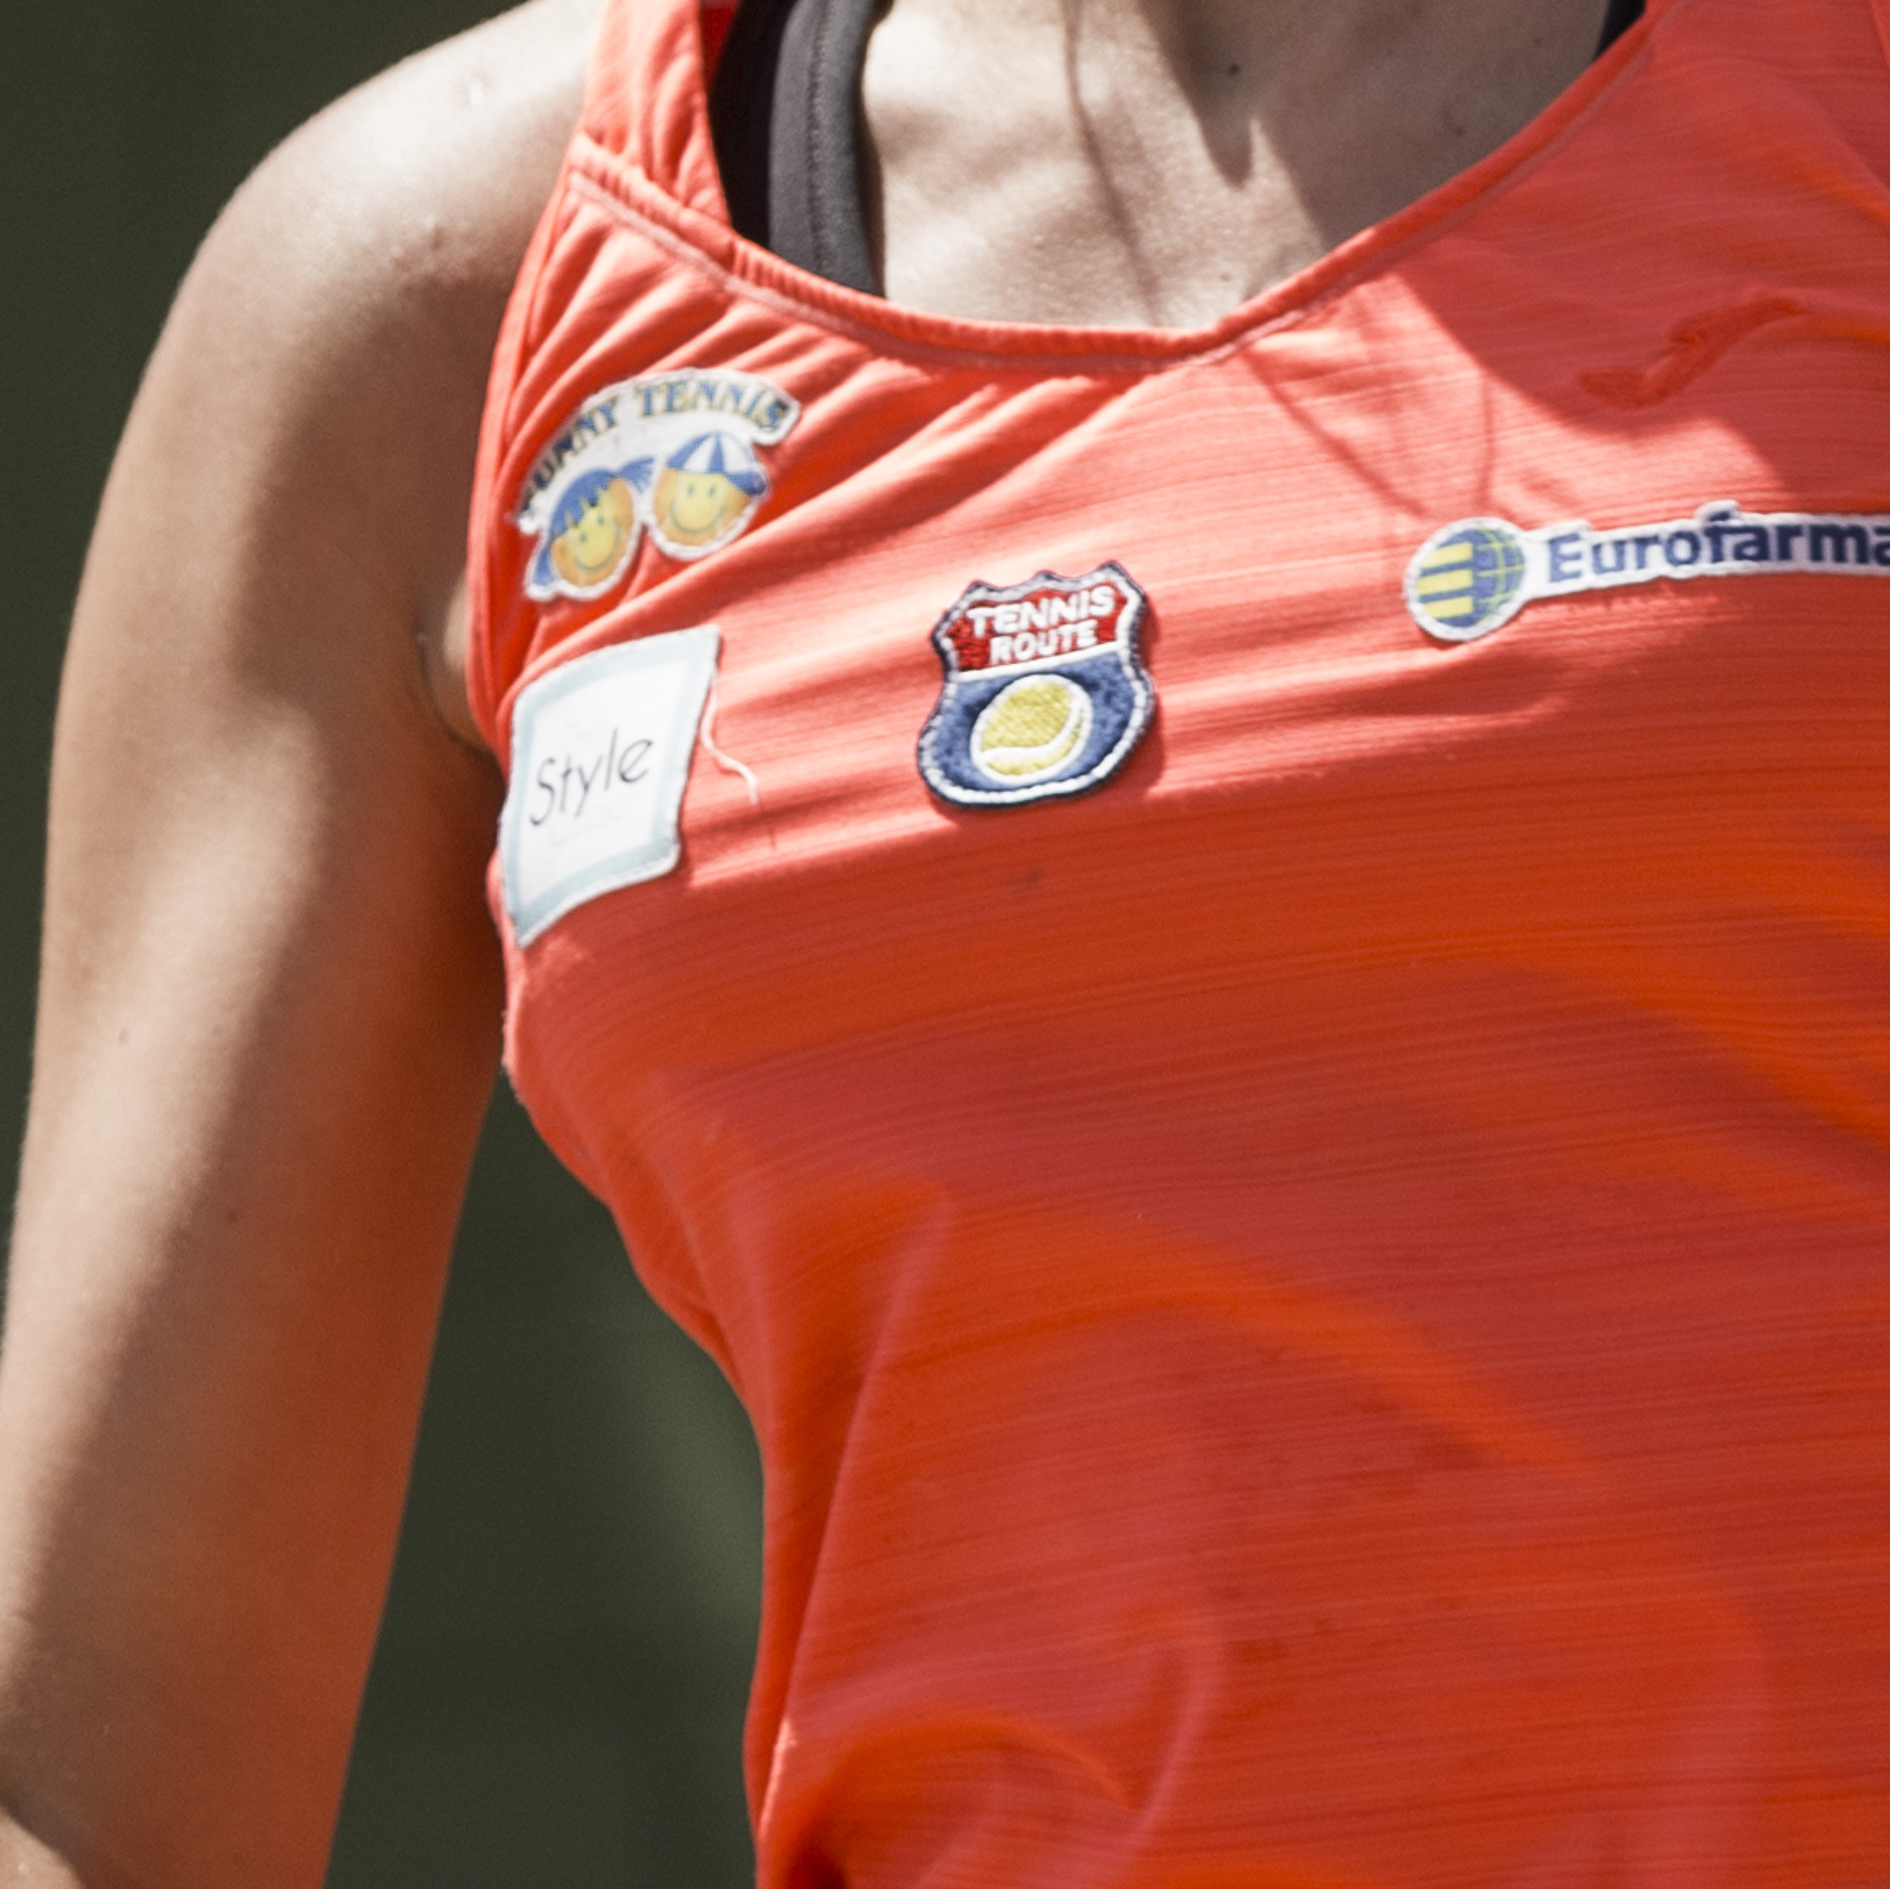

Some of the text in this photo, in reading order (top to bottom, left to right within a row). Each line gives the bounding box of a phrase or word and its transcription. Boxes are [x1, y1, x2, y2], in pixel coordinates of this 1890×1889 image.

[634, 379, 791, 433] TENNIS
[966, 585, 1116, 637] TENNIS
[989, 619, 1099, 665] ROUTE
[530, 726, 654, 826] Style
